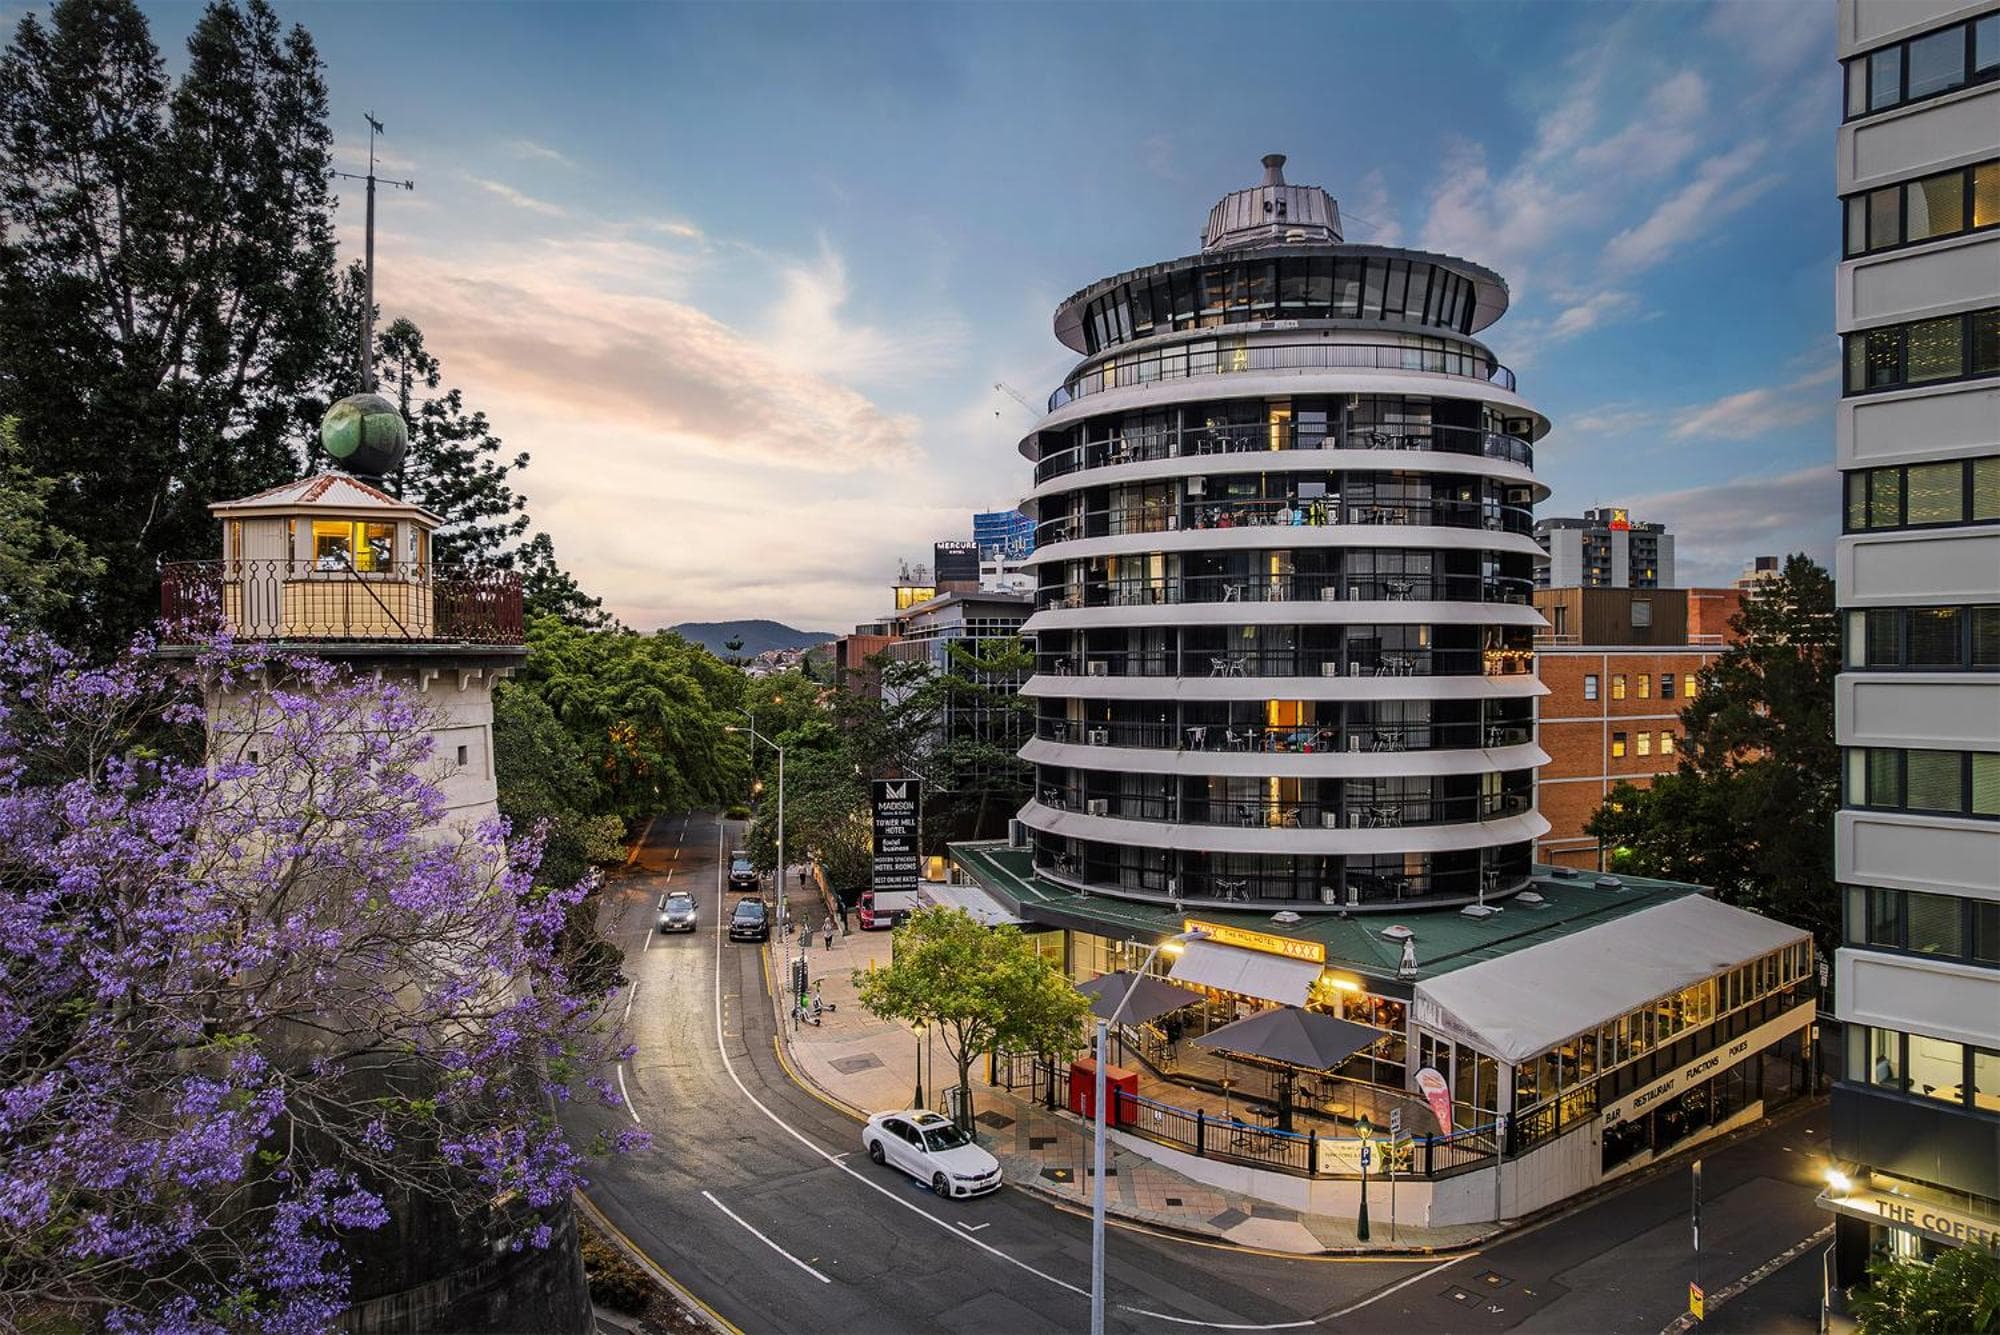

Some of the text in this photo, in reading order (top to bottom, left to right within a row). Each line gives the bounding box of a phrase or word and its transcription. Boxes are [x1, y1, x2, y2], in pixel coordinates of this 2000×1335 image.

[878, 801, 914, 811] MADISON
[876, 818, 916, 827] TOWER MILL
[885, 826, 906, 834] HOTEL
[874, 862, 917, 871] HOTEL ROOMS
[1238, 933, 1252, 942] MILL
[1254, 936, 1275, 946] HOTEL
[1606, 1108, 1621, 1124] BAR
[1633, 1079, 1675, 1109] RESTAURANT
[1685, 1056, 1720, 1081] FUNCTIONS
[1875, 1200, 1915, 1224] THE
